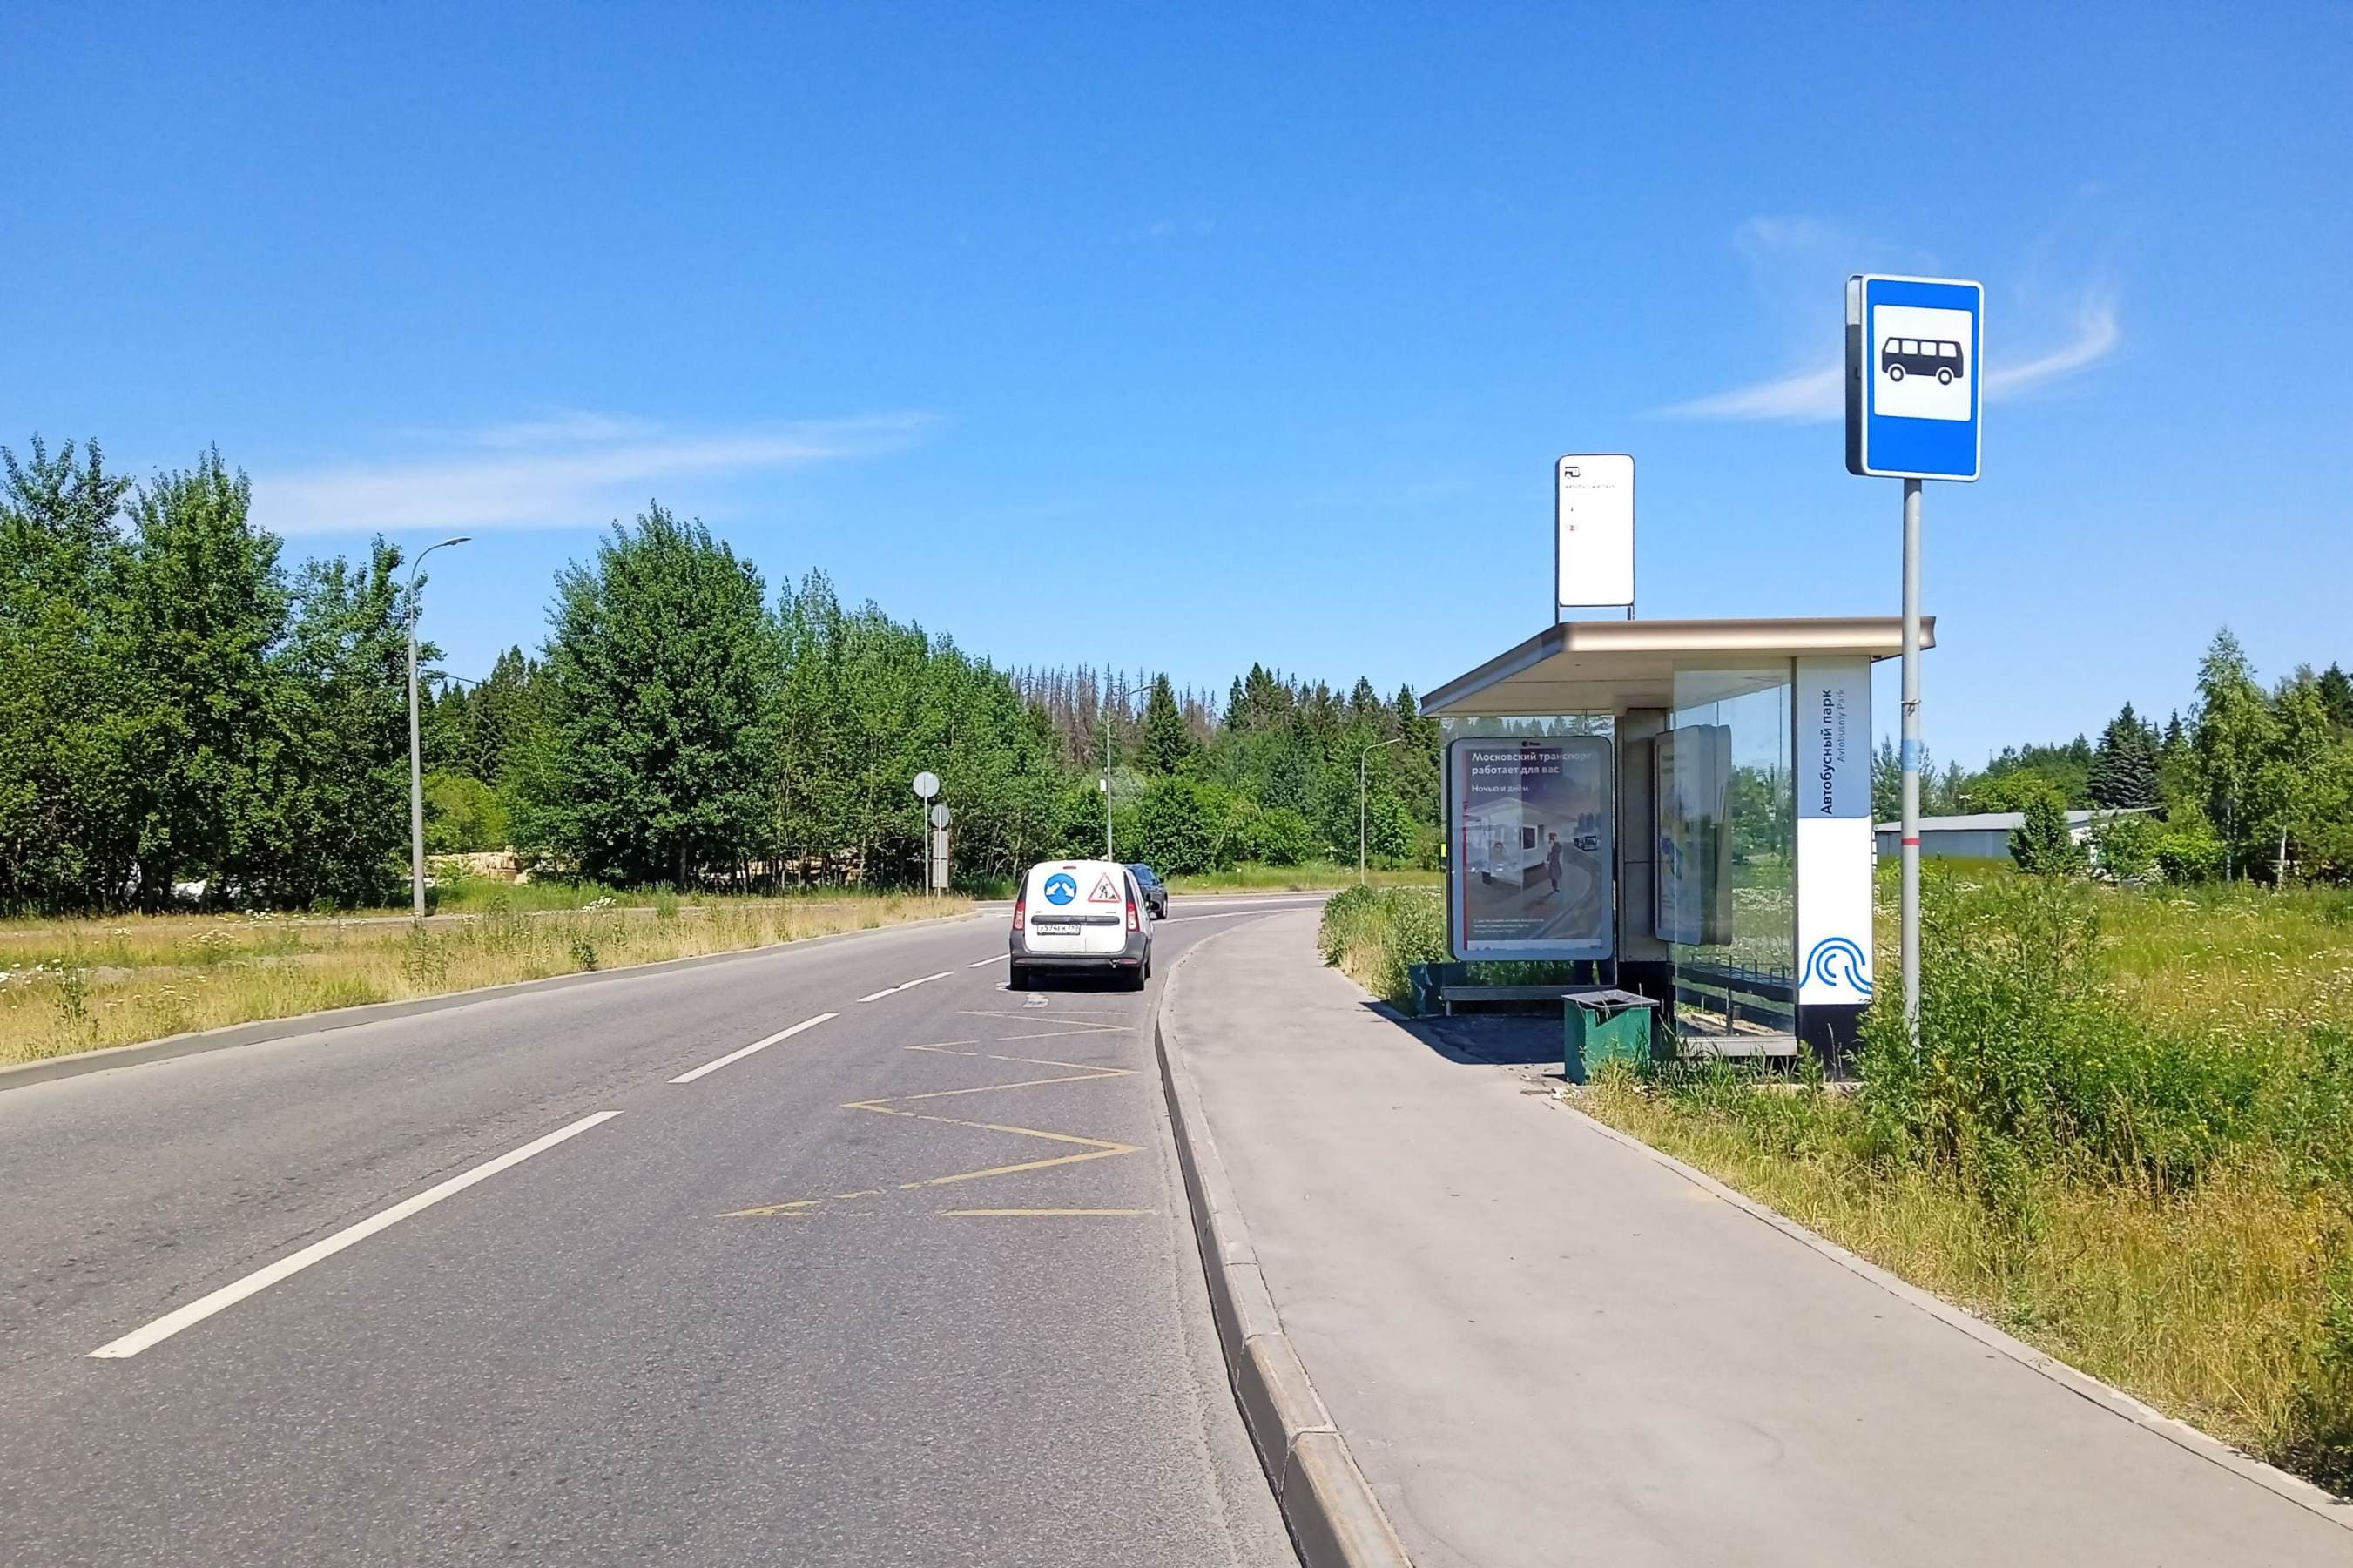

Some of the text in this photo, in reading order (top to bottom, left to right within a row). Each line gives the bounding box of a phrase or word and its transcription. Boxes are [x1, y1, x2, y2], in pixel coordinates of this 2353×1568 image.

[1837, 689, 1847, 763] Avtobusniy Park
[1472, 752, 1593, 764] Московский транспорт
[1472, 765, 1519, 777] работает
[1520, 766, 1540, 775] для
[1820, 690, 1835, 815] Автобусный парк
